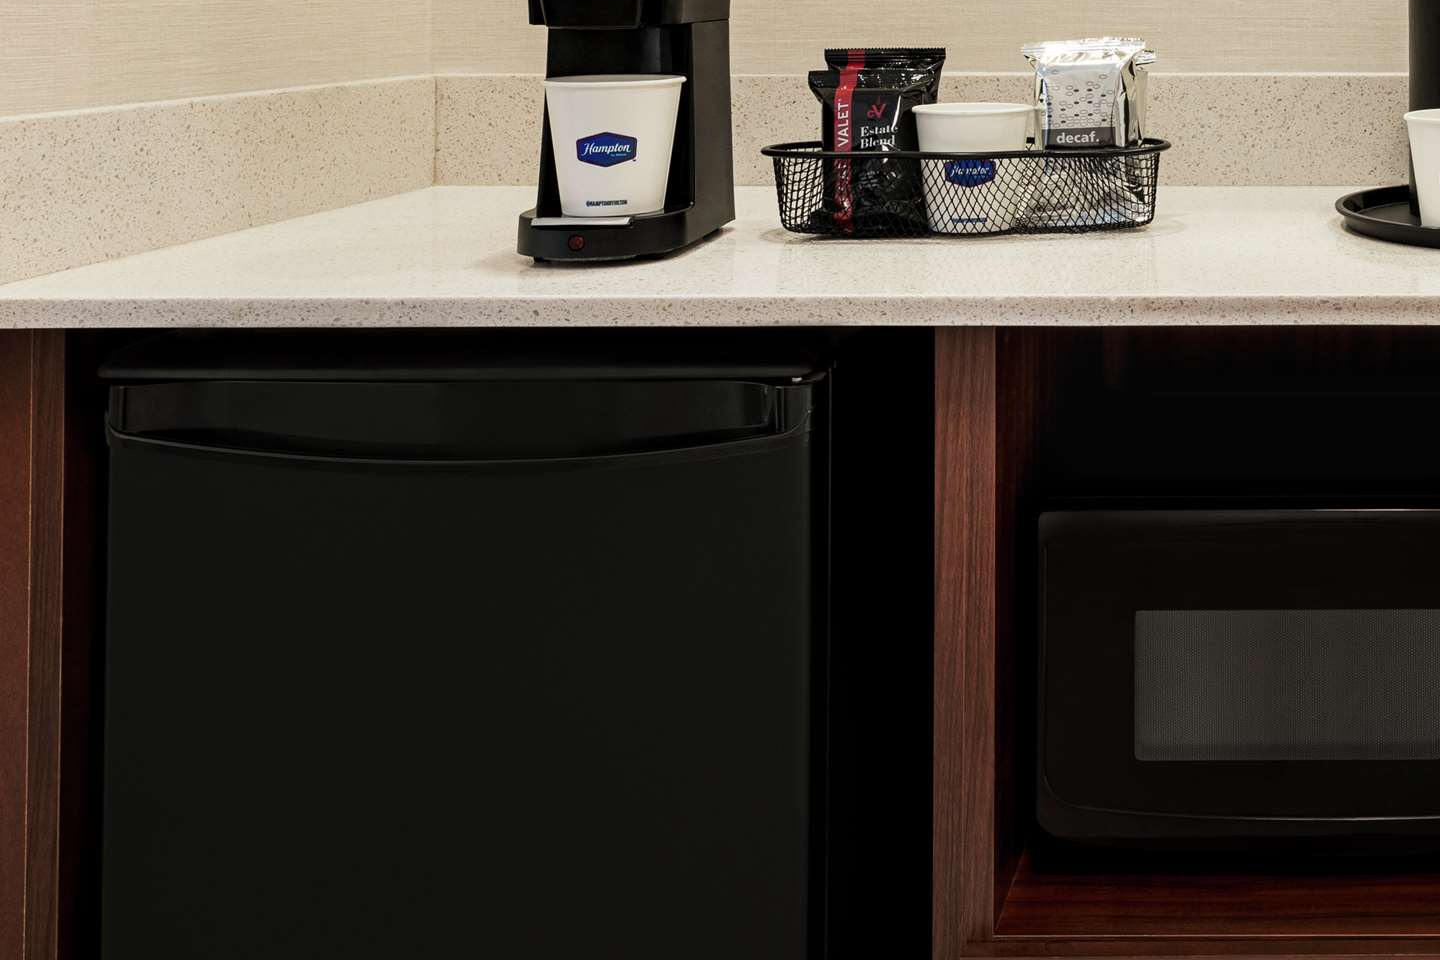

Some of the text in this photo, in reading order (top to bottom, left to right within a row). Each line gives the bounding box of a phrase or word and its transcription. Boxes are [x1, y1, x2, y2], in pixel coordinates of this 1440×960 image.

[838, 103, 848, 147] VALET
[860, 126, 897, 137] Estate
[860, 135, 895, 149] Blend
[1056, 131, 1100, 144] decaf.
[581, 142, 631, 156] Hampton
